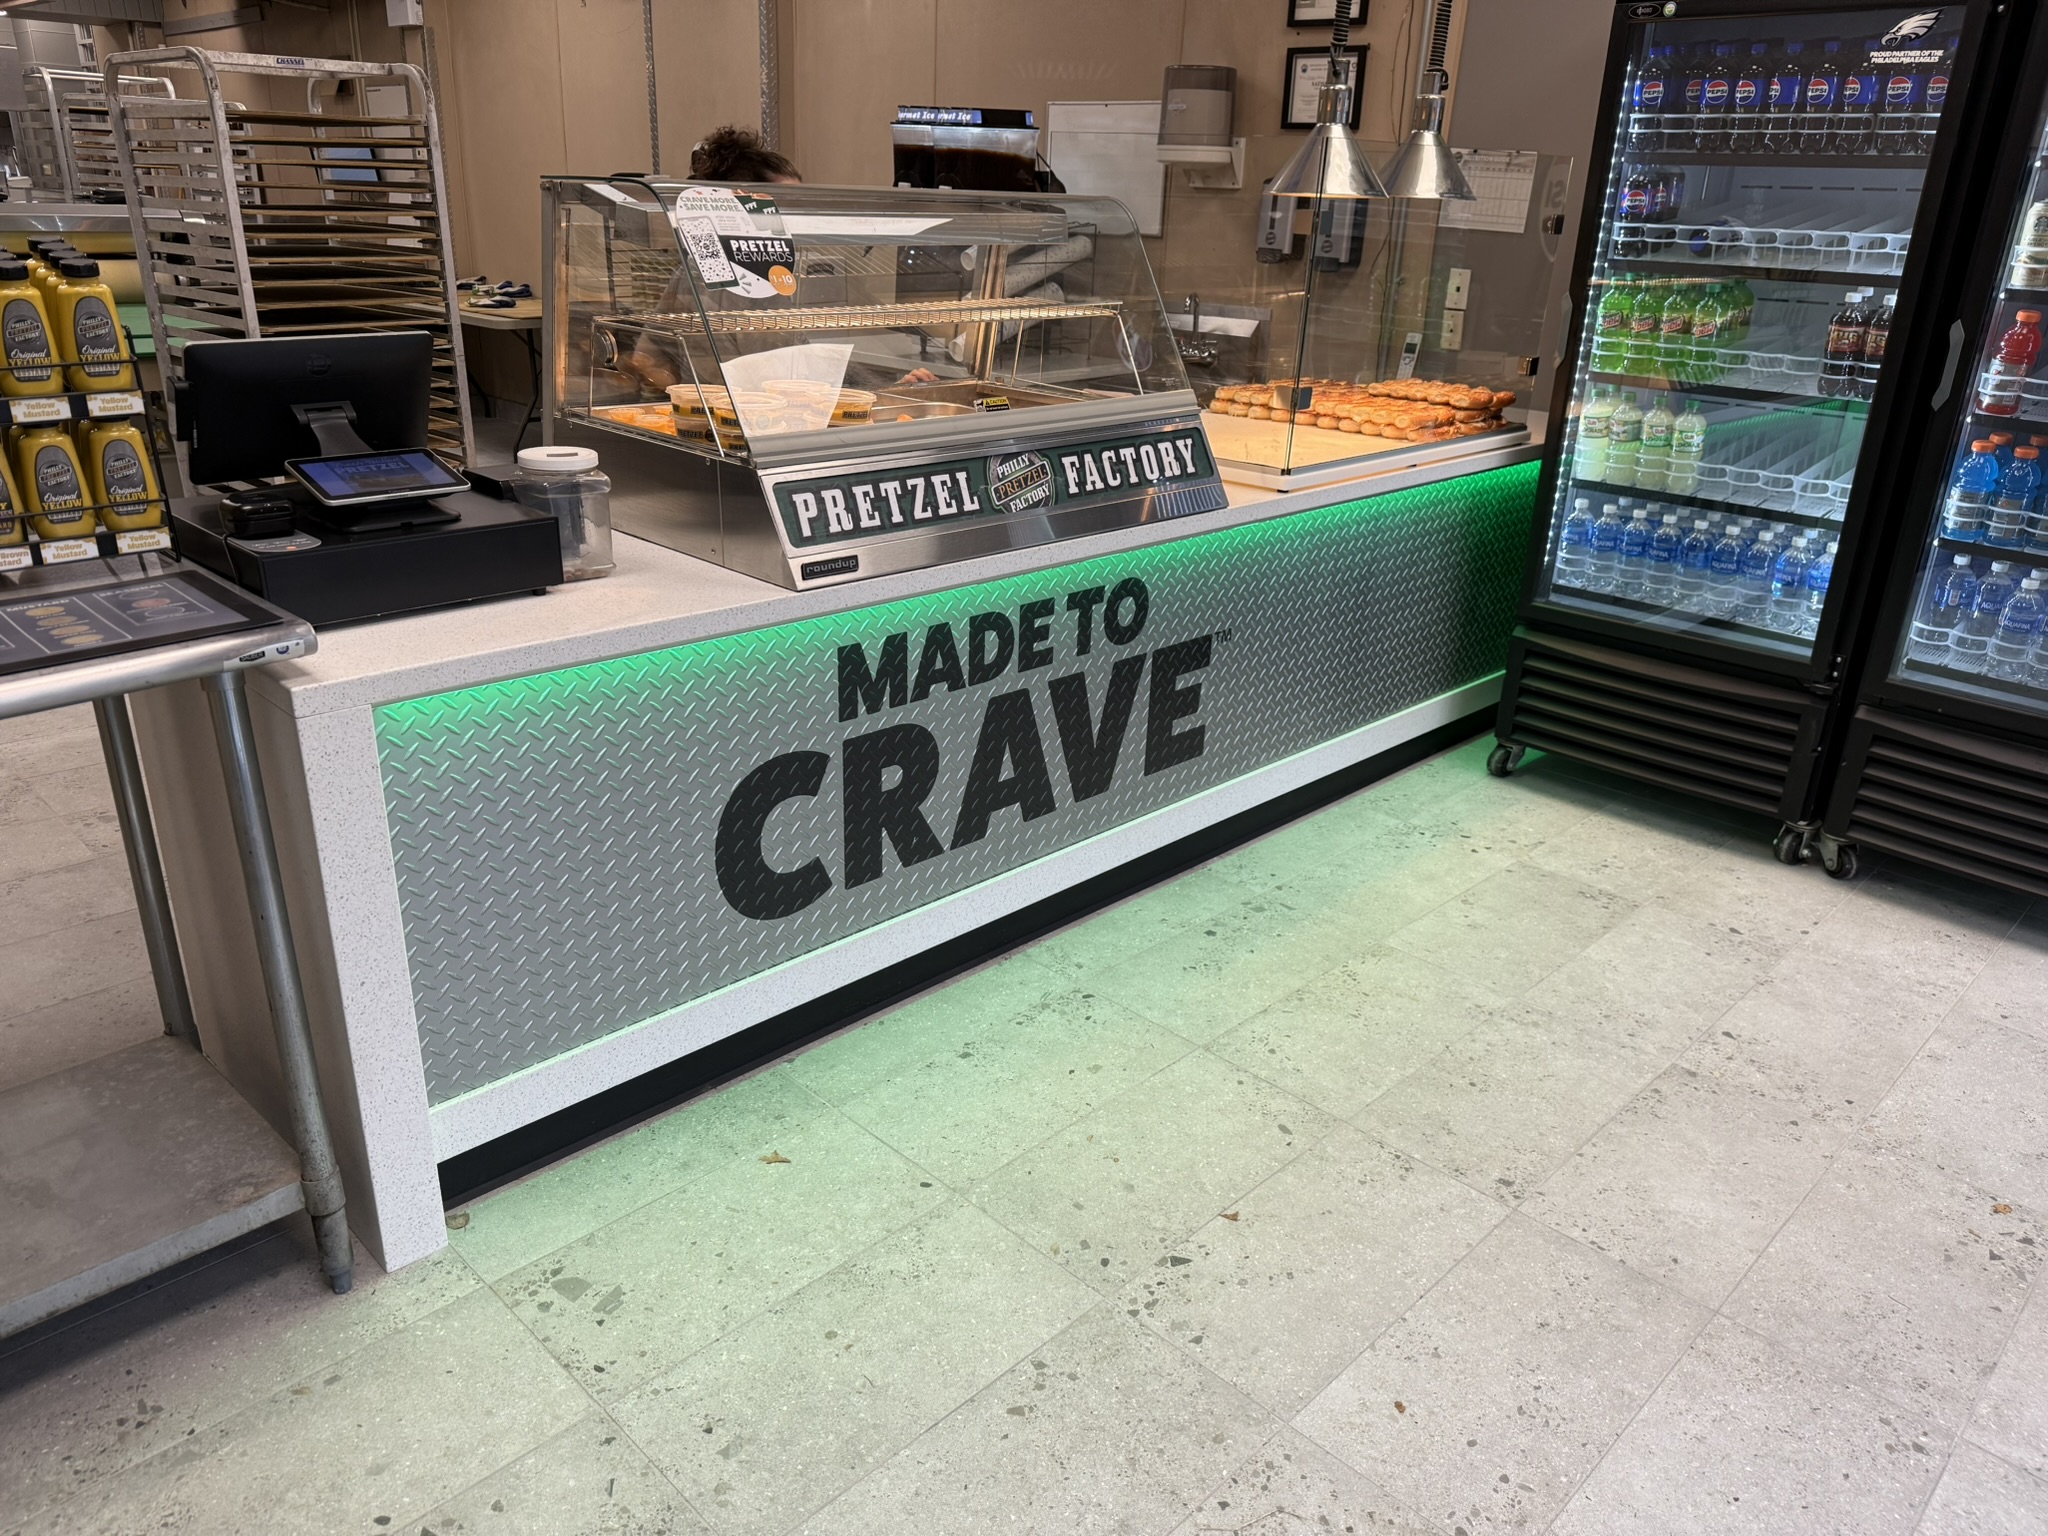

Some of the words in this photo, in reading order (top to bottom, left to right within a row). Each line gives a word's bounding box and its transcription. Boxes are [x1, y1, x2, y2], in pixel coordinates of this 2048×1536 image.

[1643, 89, 1663, 97] PEPSI
[1707, 88, 1728, 96] PEPSI
[922, 111, 935, 120] Ice
[957, 111, 972, 121] Ice
[684, 203, 710, 211] SAVE
[730, 240, 790, 252] PRETZEL
[733, 251, 794, 263] REWARDS
[11, 349, 48, 362] Original
[82, 344, 116, 356] Original
[8, 356, 51, 367] YELLOW
[80, 352, 120, 363] YELLOW
[25, 401, 55, 410] Yellow
[100, 396, 128, 405] Yellow
[23, 409, 61, 418] Mustard
[98, 404, 134, 412] Mustard
[336, 461, 410, 474] PRETZEL
[996, 453, 1030, 478] PHILLY
[792, 471, 980, 538] PRETZEL
[1061, 438, 1196, 494] FACTORY
[998, 467, 1046, 498] PRETZEL
[110, 484, 143, 495] Original
[44, 490, 78, 502] Original
[109, 492, 147, 503] YELLOW
[1010, 483, 1050, 513] FACTORY
[42, 498, 82, 510] YELLOW
[129, 533, 156, 542] Yellow
[54, 543, 82, 552] Yellow
[127, 540, 161, 550] Mustard
[53, 549, 88, 560] Mustard
[0, 558, 22, 569] stard
[806, 558, 857, 574] roundup
[2003, 620, 2031, 630] AQUAFINA
[836, 597, 1057, 723] MADE
[1066, 576, 1150, 657] TO
[715, 634, 1214, 921] CRAVE
